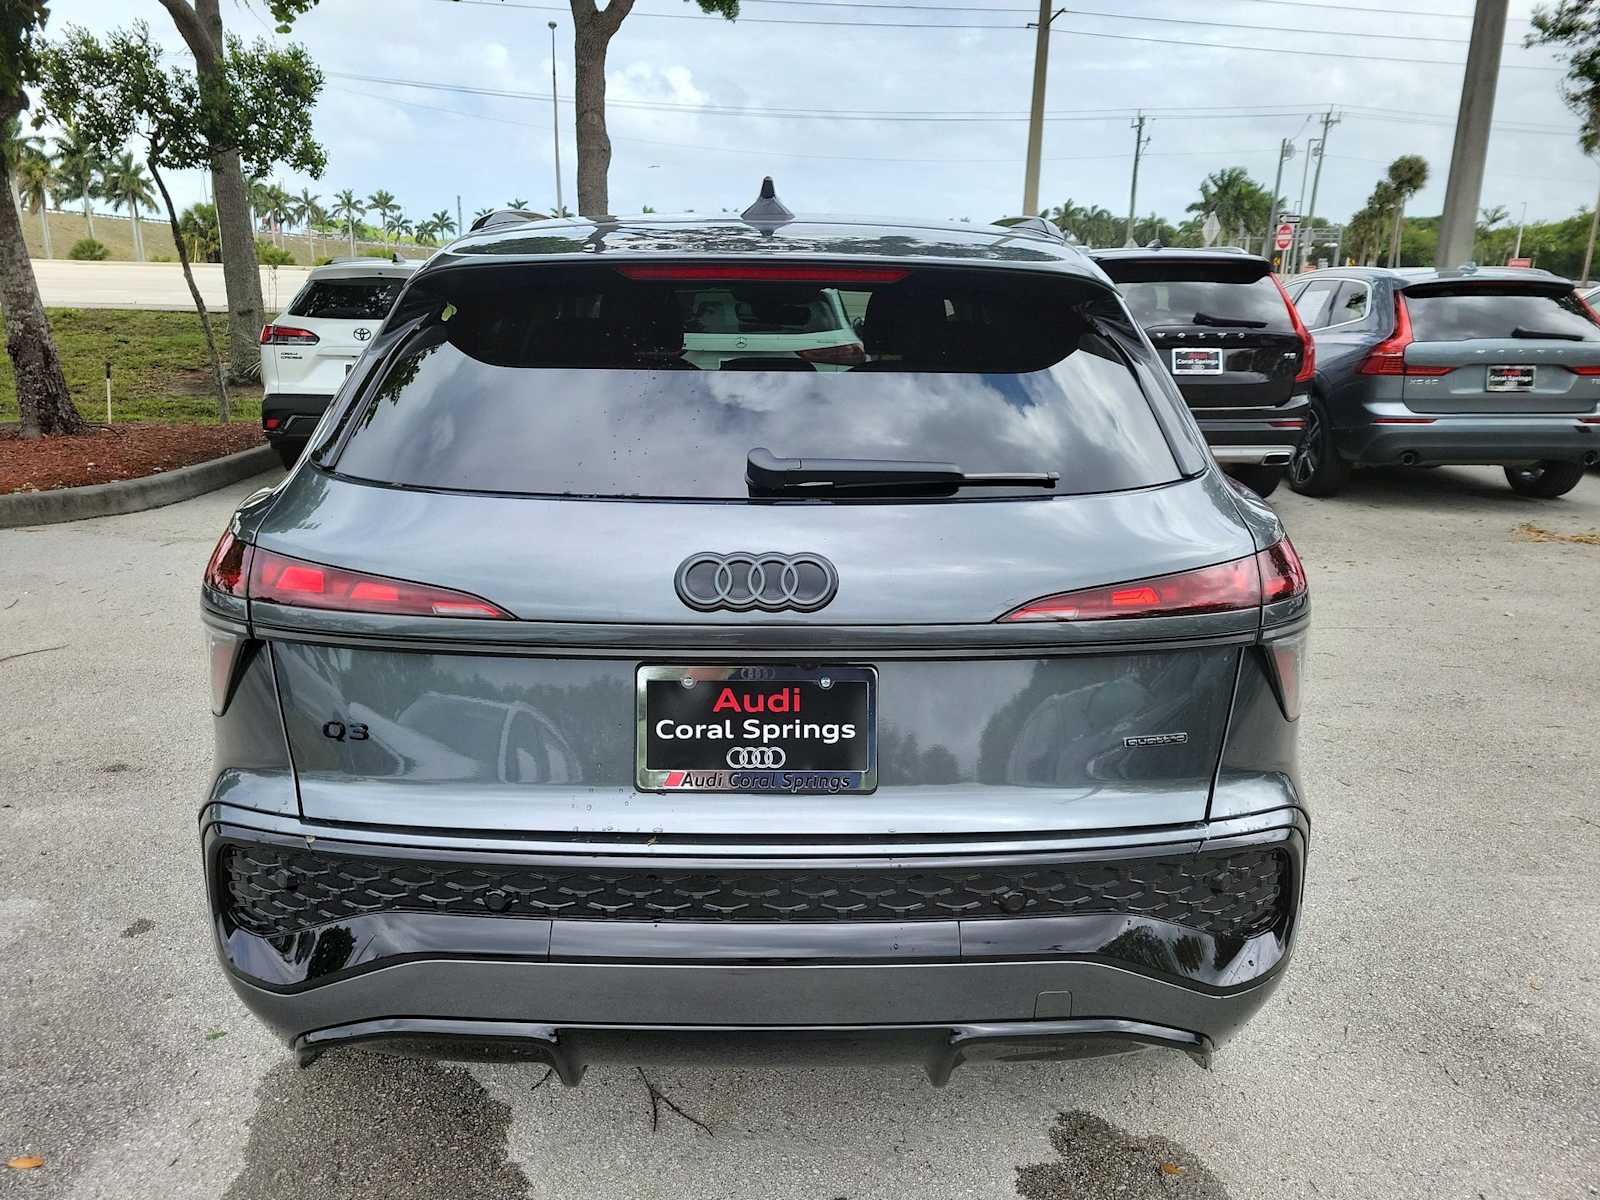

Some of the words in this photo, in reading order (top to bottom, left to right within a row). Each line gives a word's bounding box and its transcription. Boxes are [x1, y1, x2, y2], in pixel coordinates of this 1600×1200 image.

[713, 687, 801, 713] Audi
[322, 721, 369, 743] Q3
[655, 719, 734, 740] Coral
[743, 719, 856, 744] Springs
[681, 771, 724, 787] Audi
[729, 771, 776, 788] Coral
[782, 772, 850, 792] Springs
